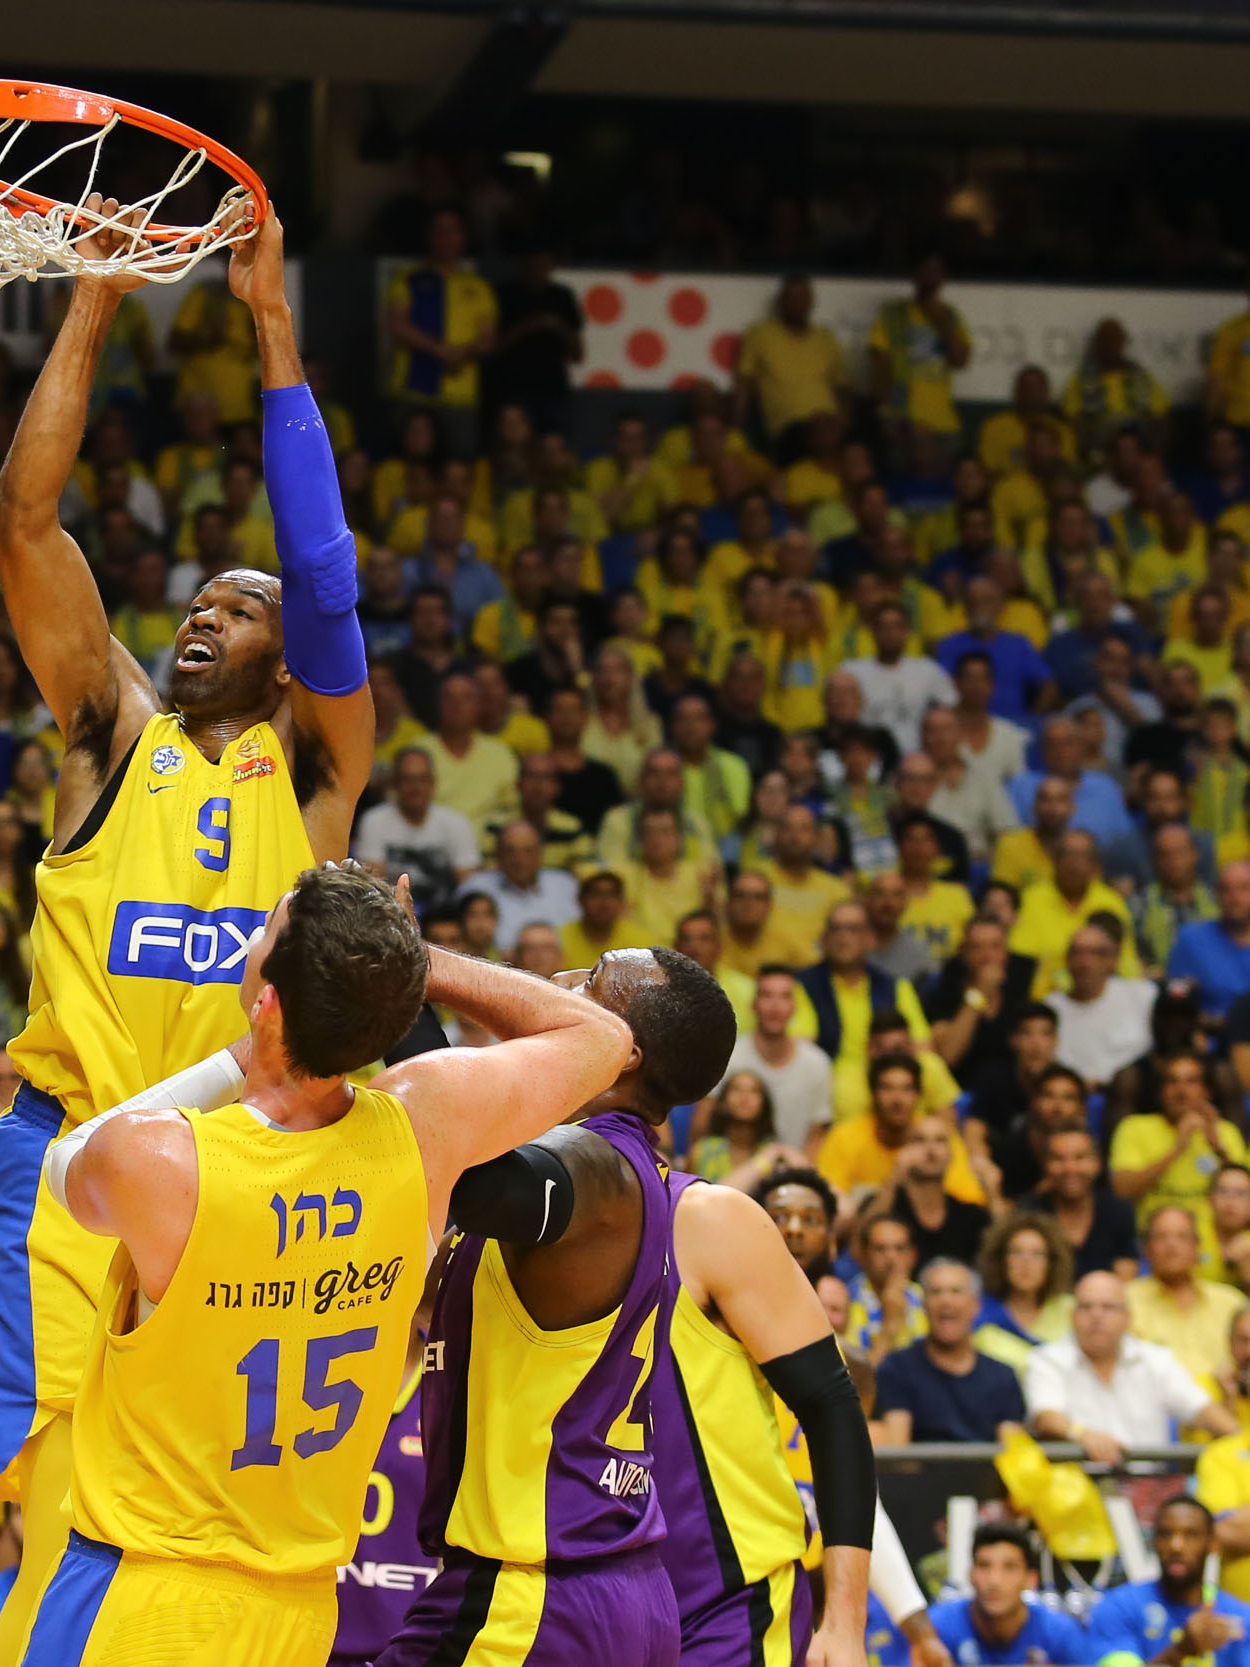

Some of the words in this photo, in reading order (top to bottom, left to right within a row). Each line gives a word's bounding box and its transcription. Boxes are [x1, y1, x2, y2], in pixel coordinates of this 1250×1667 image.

[194, 796, 231, 873] 9
[126, 915, 267, 973] FOX
[269, 1185, 363, 1260] כהן
[204, 1281, 243, 1309] גרג
[251, 1280, 296, 1310] קפה
[313, 1255, 405, 1316] greg
[337, 1294, 373, 1312] CAFE
[230, 1325, 379, 1472] 15
